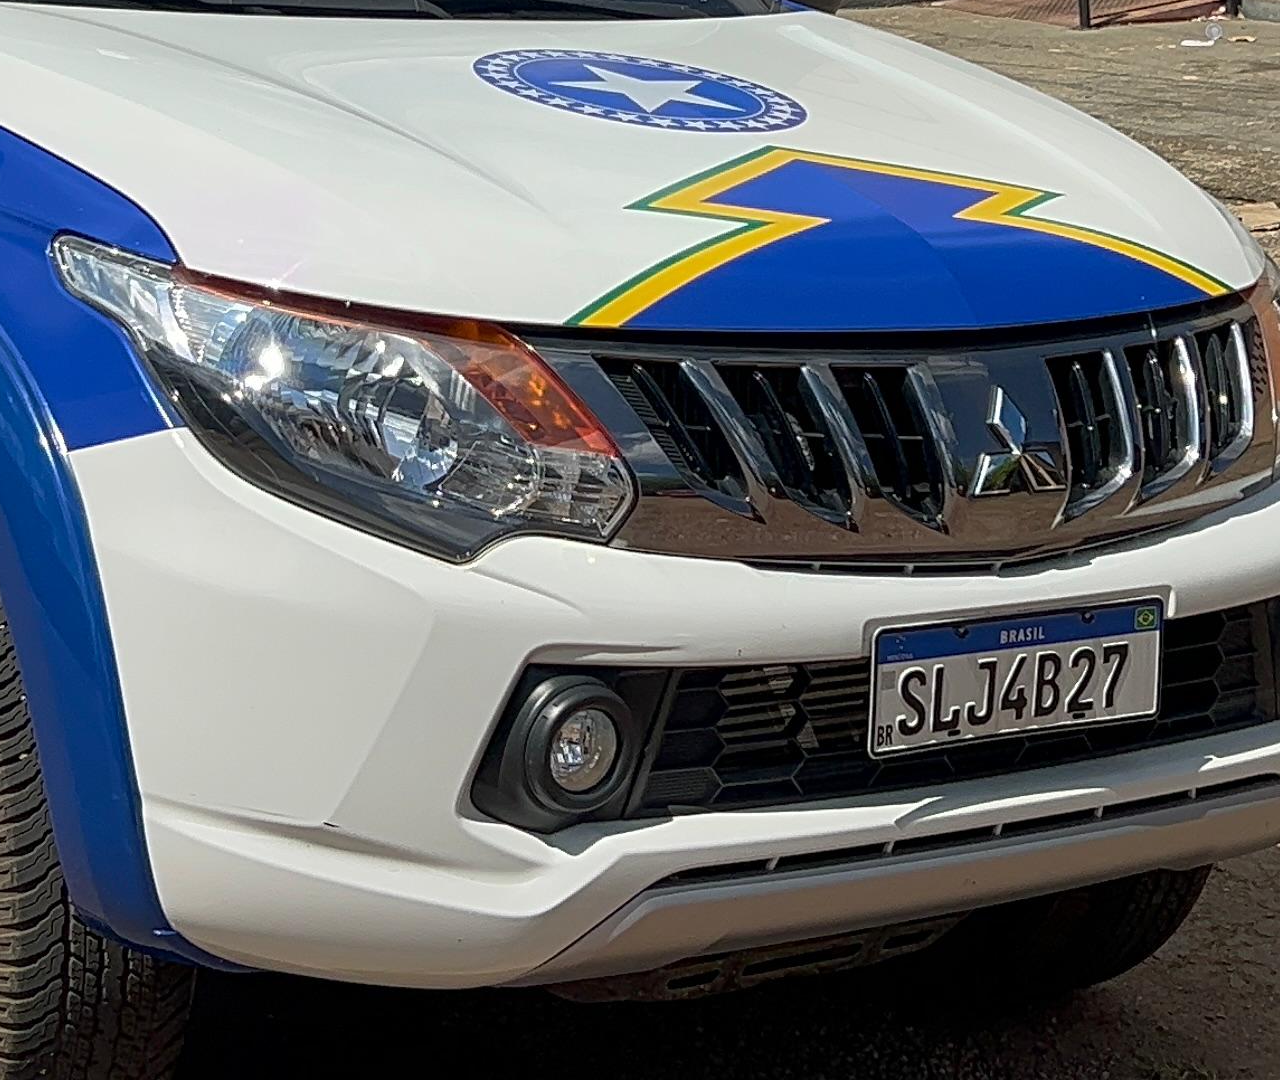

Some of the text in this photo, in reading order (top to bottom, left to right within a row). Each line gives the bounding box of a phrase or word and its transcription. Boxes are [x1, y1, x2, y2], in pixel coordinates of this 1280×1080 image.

[999, 625, 1046, 645] BRASIL
[894, 640, 1130, 738] SLJ4B27
[877, 724, 894, 747] BR
